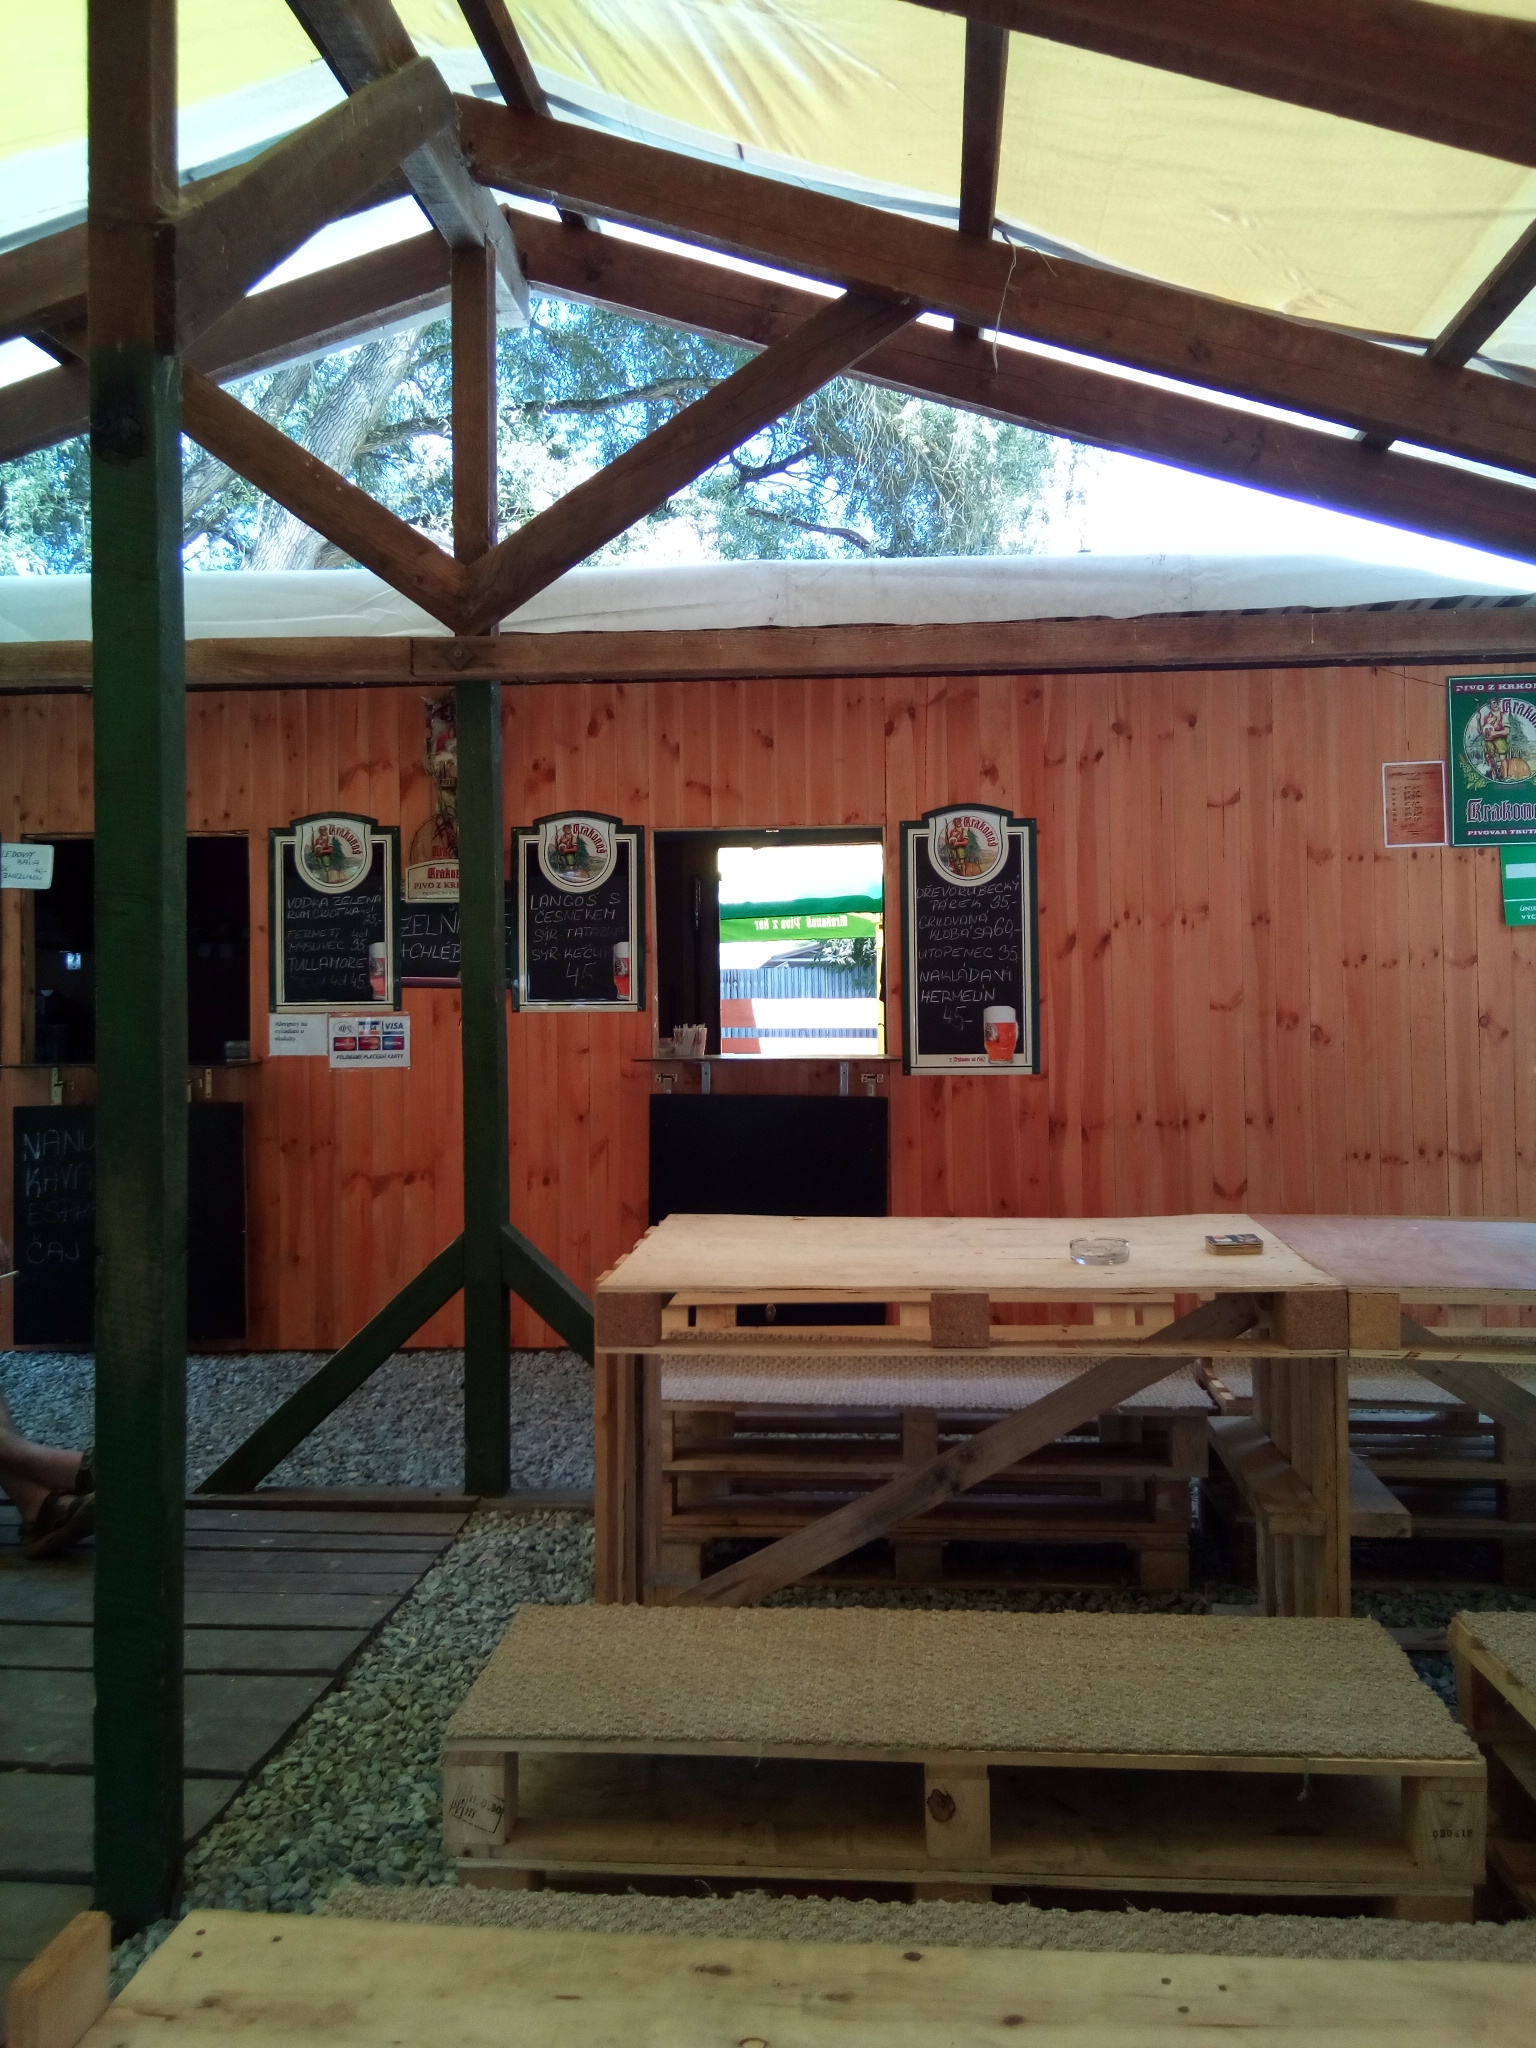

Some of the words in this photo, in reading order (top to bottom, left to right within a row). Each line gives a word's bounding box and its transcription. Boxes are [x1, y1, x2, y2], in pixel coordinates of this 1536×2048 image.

[1456, 684, 1484, 692] PIVO
[413, 882, 435, 890] PIVO
[608, 892, 622, 905] S
[401, 904, 460, 937] ZELŇ
[918, 945, 994, 960] UTOPENEC
[284, 956, 368, 972] TULLAMORE
[385, 1021, 404, 1030] VISA
